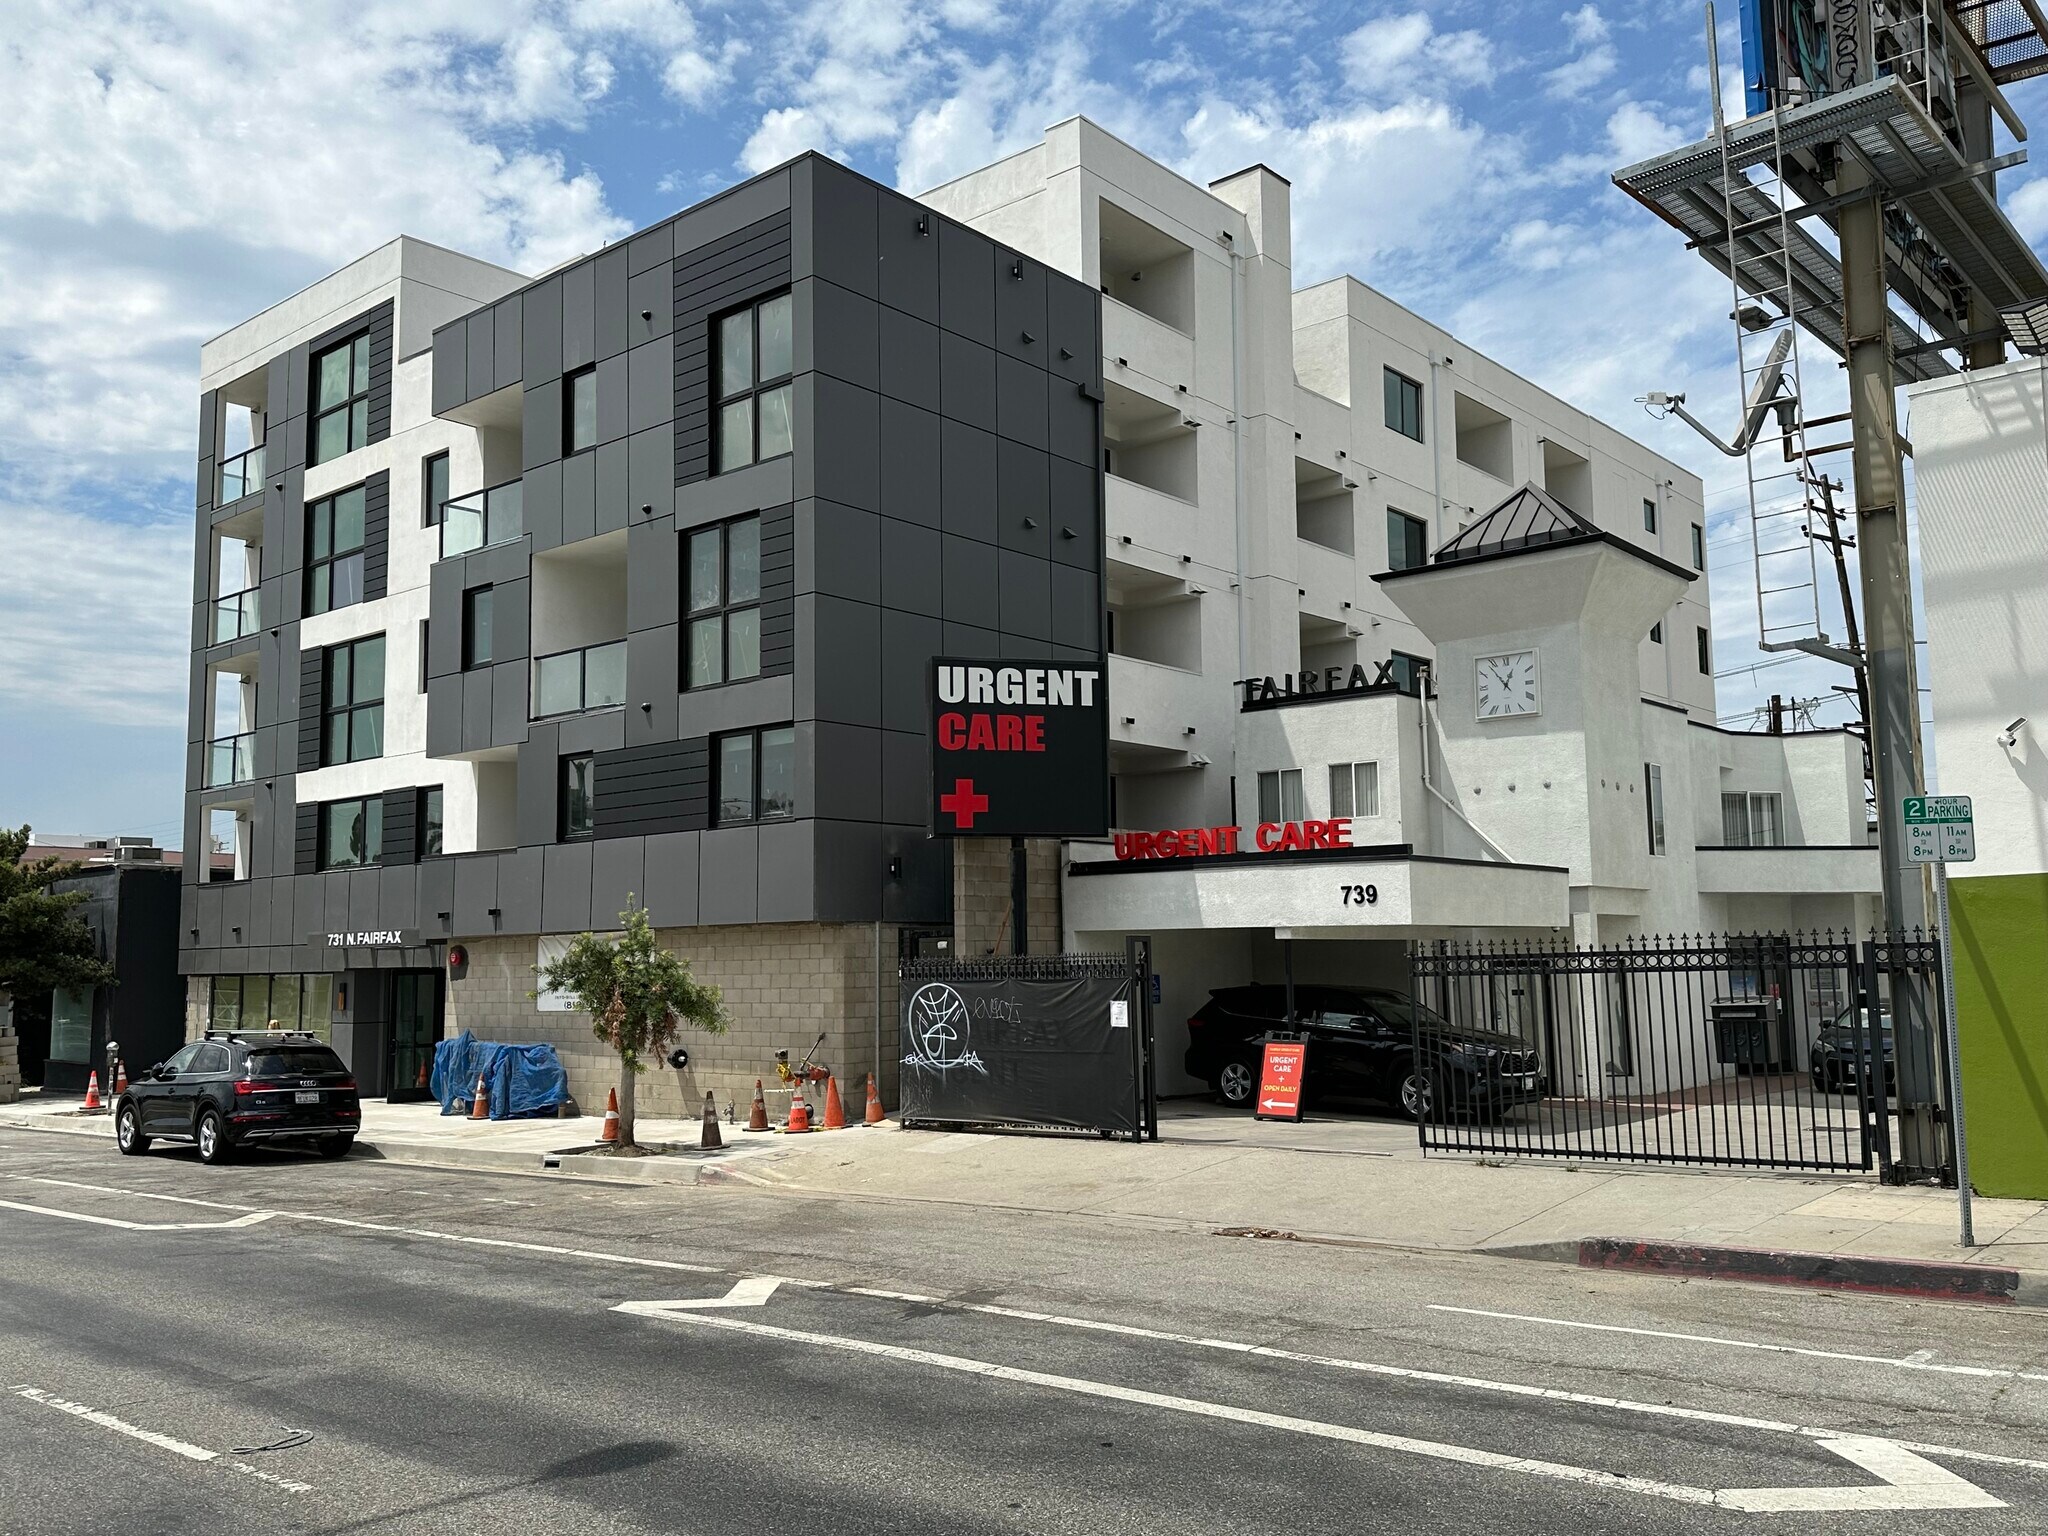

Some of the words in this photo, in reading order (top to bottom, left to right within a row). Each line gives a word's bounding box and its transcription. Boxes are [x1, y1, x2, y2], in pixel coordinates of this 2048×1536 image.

[938, 666, 1099, 706] URGENT
[1246, 659, 1396, 701] FAIRFAX
[938, 712, 1046, 752] CARE
[1908, 800, 1921, 817] 2
[1928, 805, 1969, 817] PARKING
[1114, 826, 1243, 861] URGENT
[1256, 818, 1355, 853] CARE
[1341, 884, 1379, 905] 739
[327, 933, 344, 947] 731
[1270, 1056, 1297, 1064] URGENT
